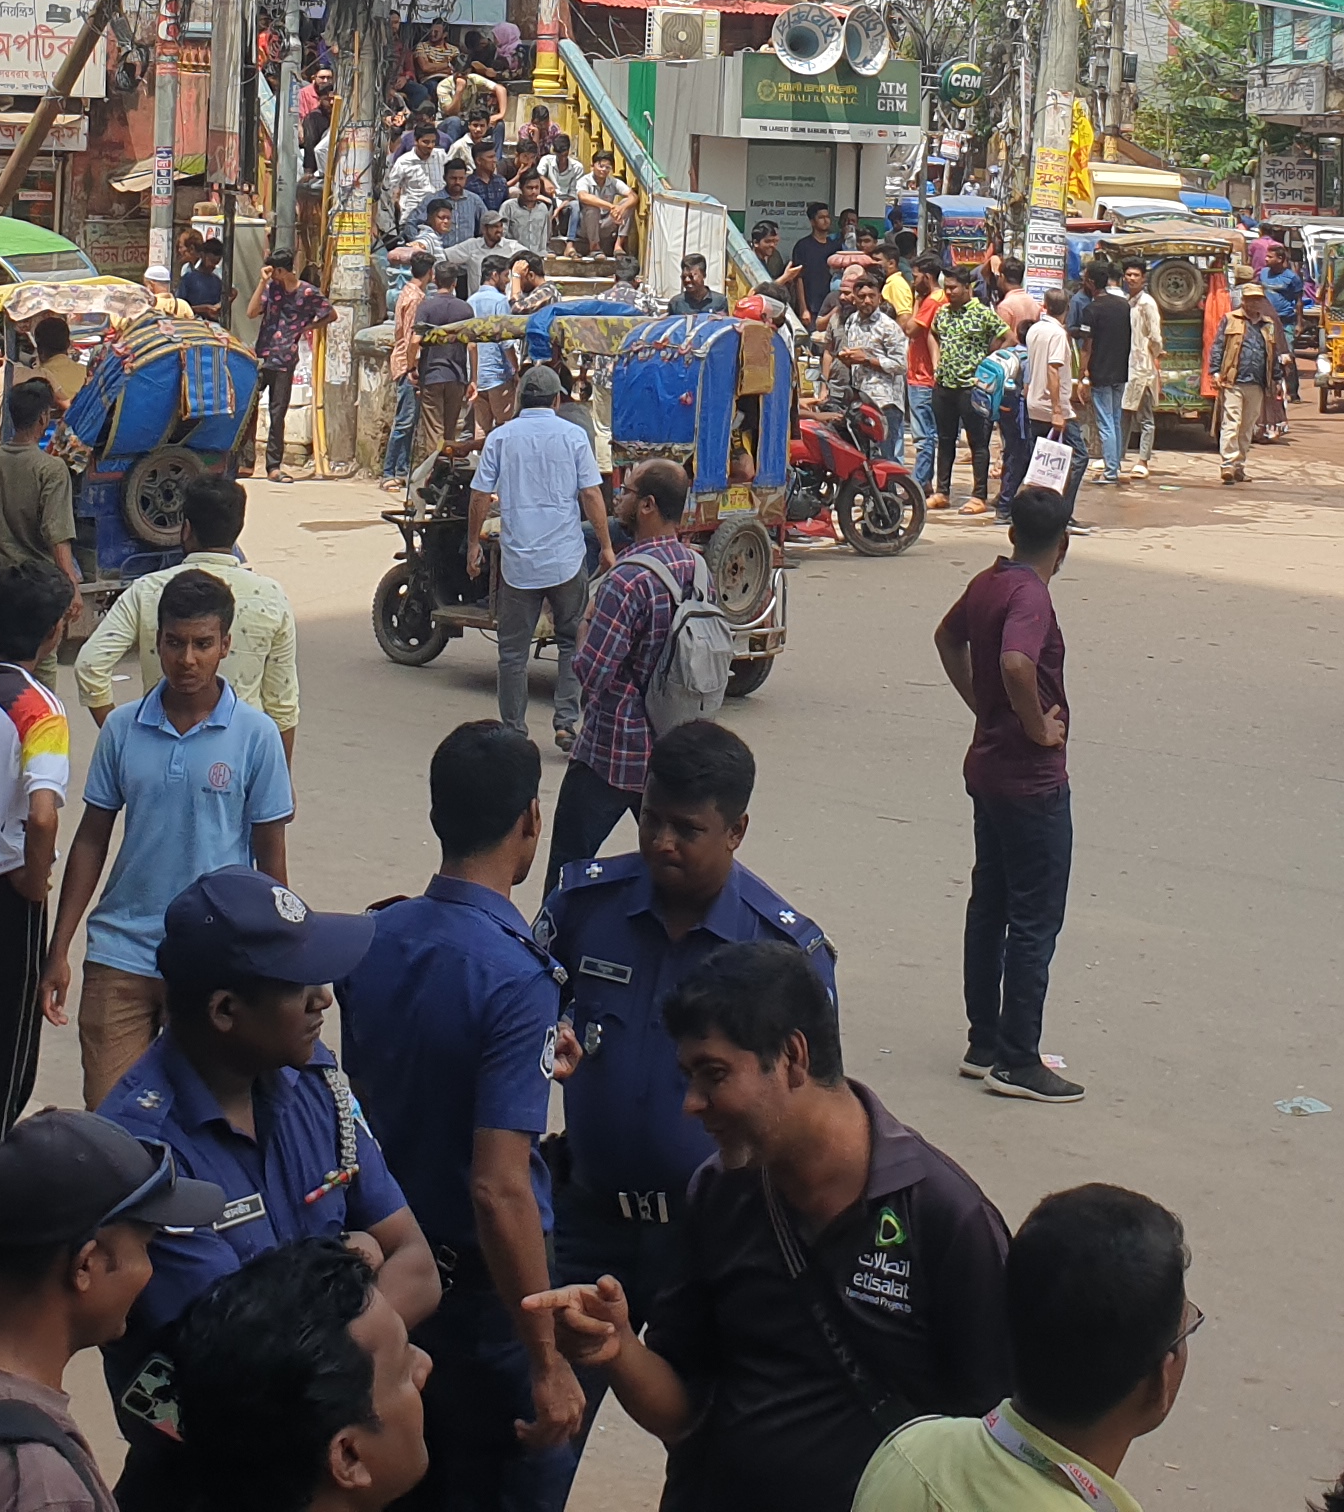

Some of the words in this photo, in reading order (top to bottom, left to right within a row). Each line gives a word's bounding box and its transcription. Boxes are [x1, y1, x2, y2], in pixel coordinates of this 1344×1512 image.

[878, 82, 907, 95] ATM
[950, 73, 981, 89] CRM
[877, 99, 907, 112] CRM
[858, 1252, 911, 1278] اتصالات
[853, 1271, 910, 1300] etisalat
